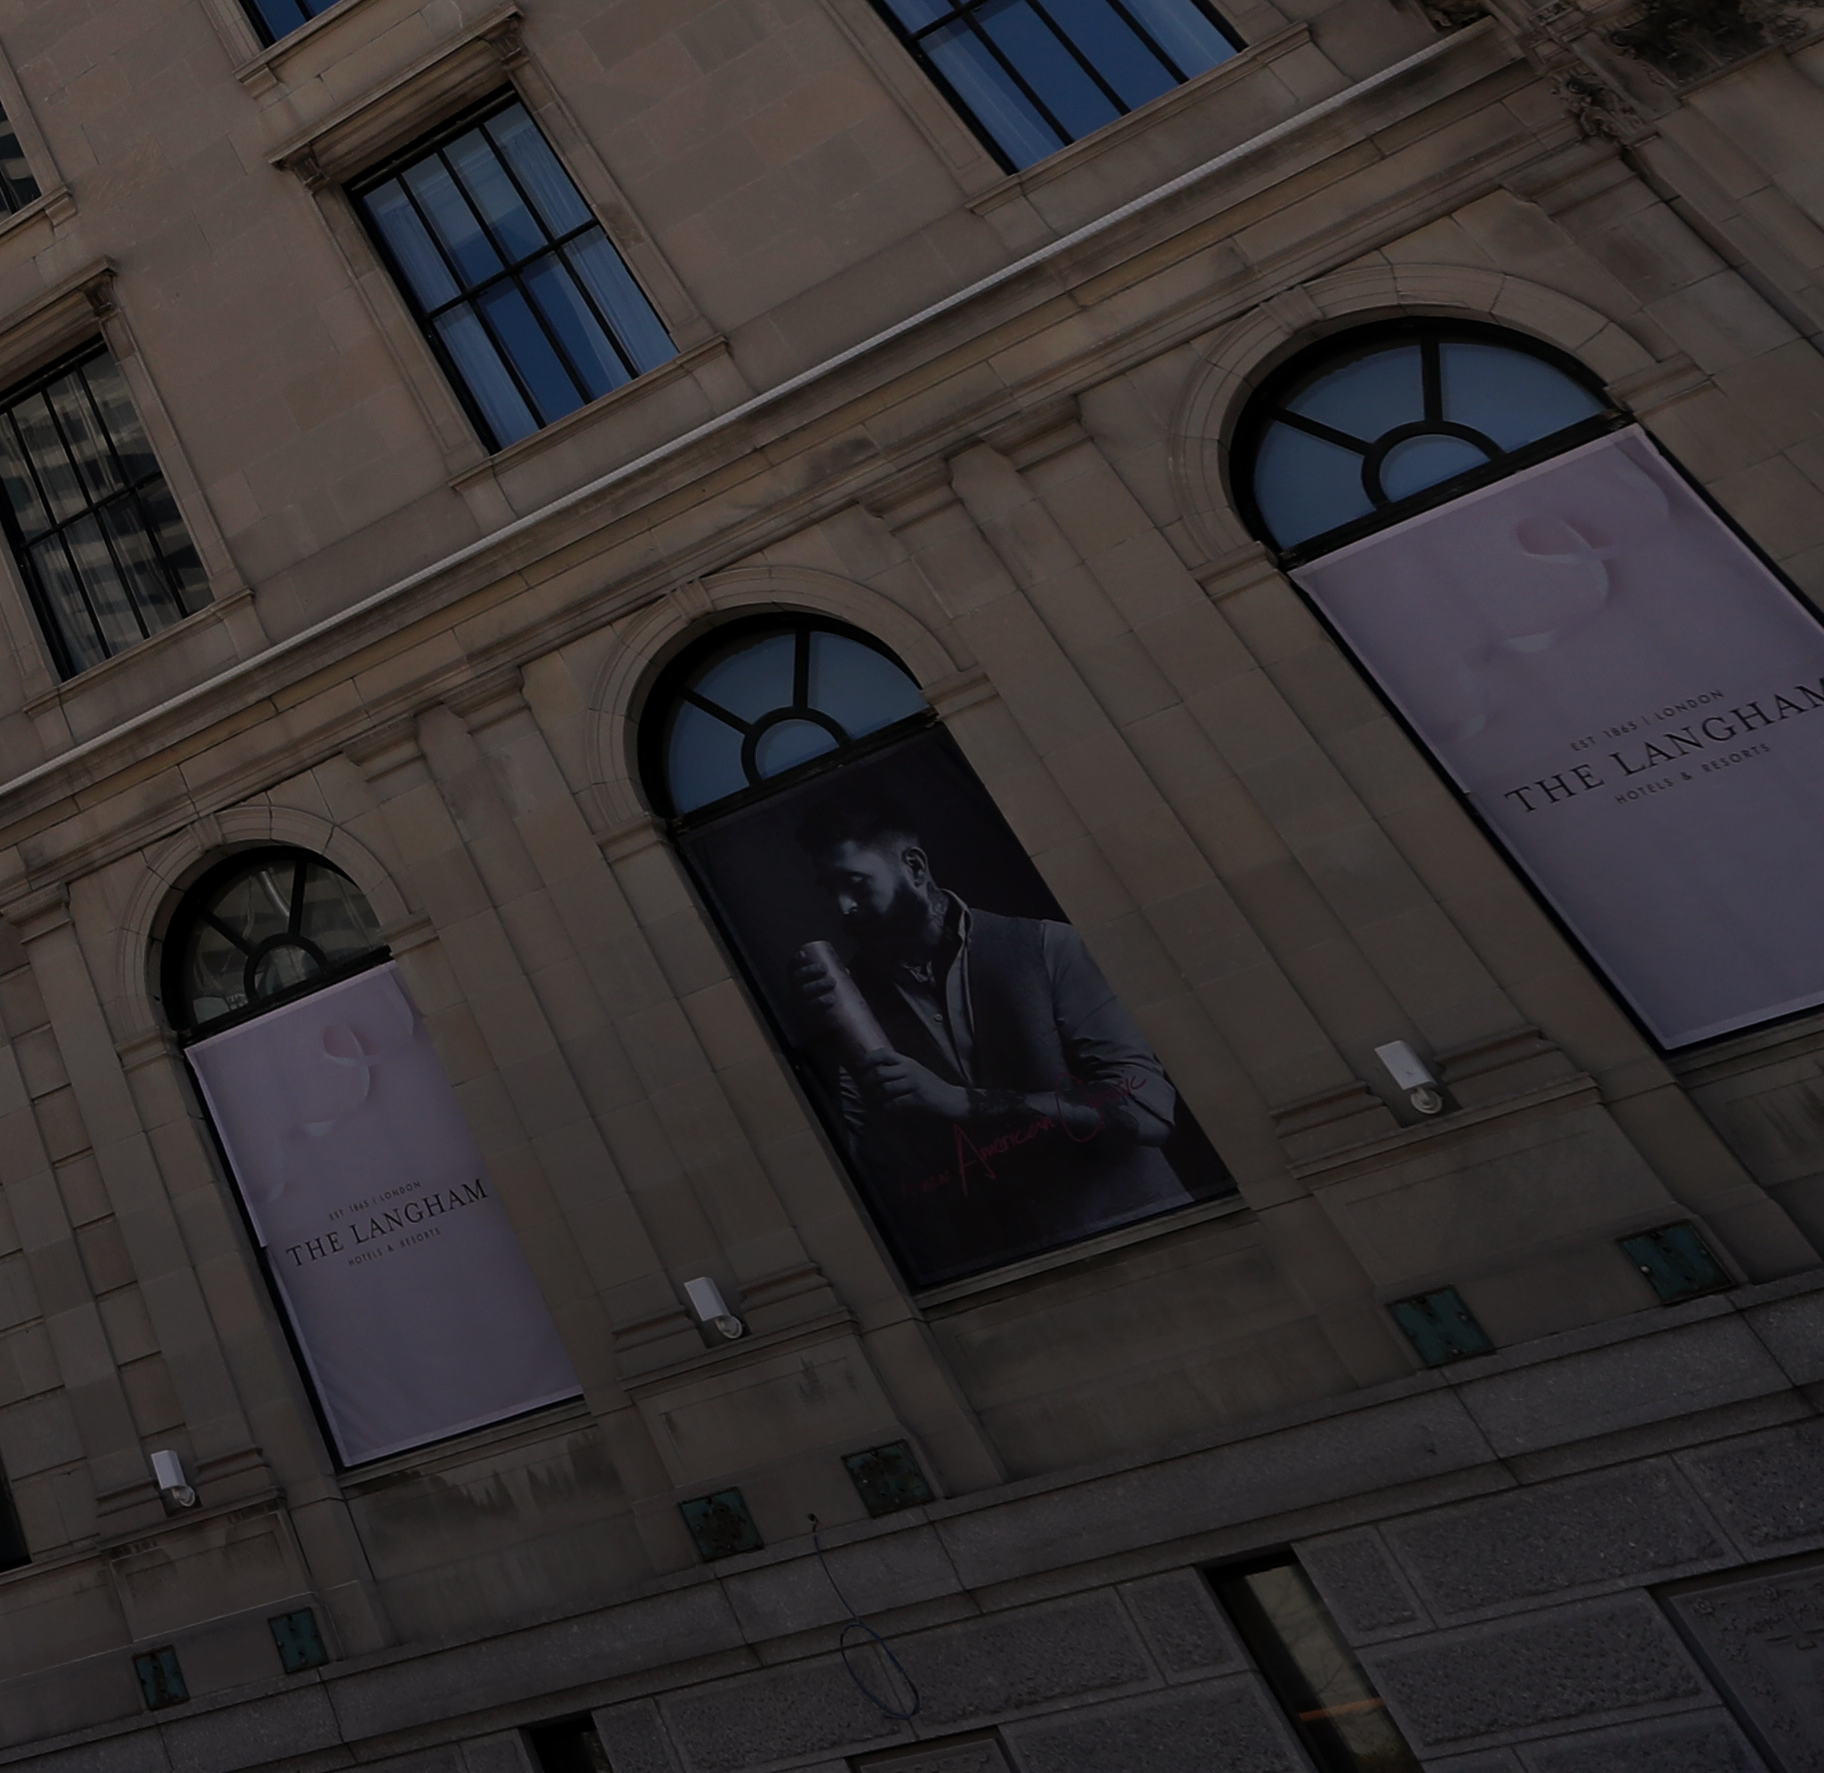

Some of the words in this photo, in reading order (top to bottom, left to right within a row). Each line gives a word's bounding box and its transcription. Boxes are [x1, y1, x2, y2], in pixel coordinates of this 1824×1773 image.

[1504, 763, 1605, 813] THE
[1609, 676, 1824, 777] LANGHAM
[1570, 736, 1597, 752] EST
[1603, 720, 1639, 739] 1865
[1654, 689, 1725, 721] LONDON
[1615, 777, 1674, 805] HOTELS
[1680, 771, 1693, 782] &
[1702, 742, 1772, 774] RESORTS
[952, 1117, 1057, 1197] American
[286, 1231, 345, 1266] THE
[350, 1178, 489, 1244] LANGHAM
[328, 1209, 344, 1221] EST
[379, 1181, 422, 1202] LONDON
[347, 1248, 383, 1266] HOTELS
[400, 1227, 442, 1249] RESORTS
